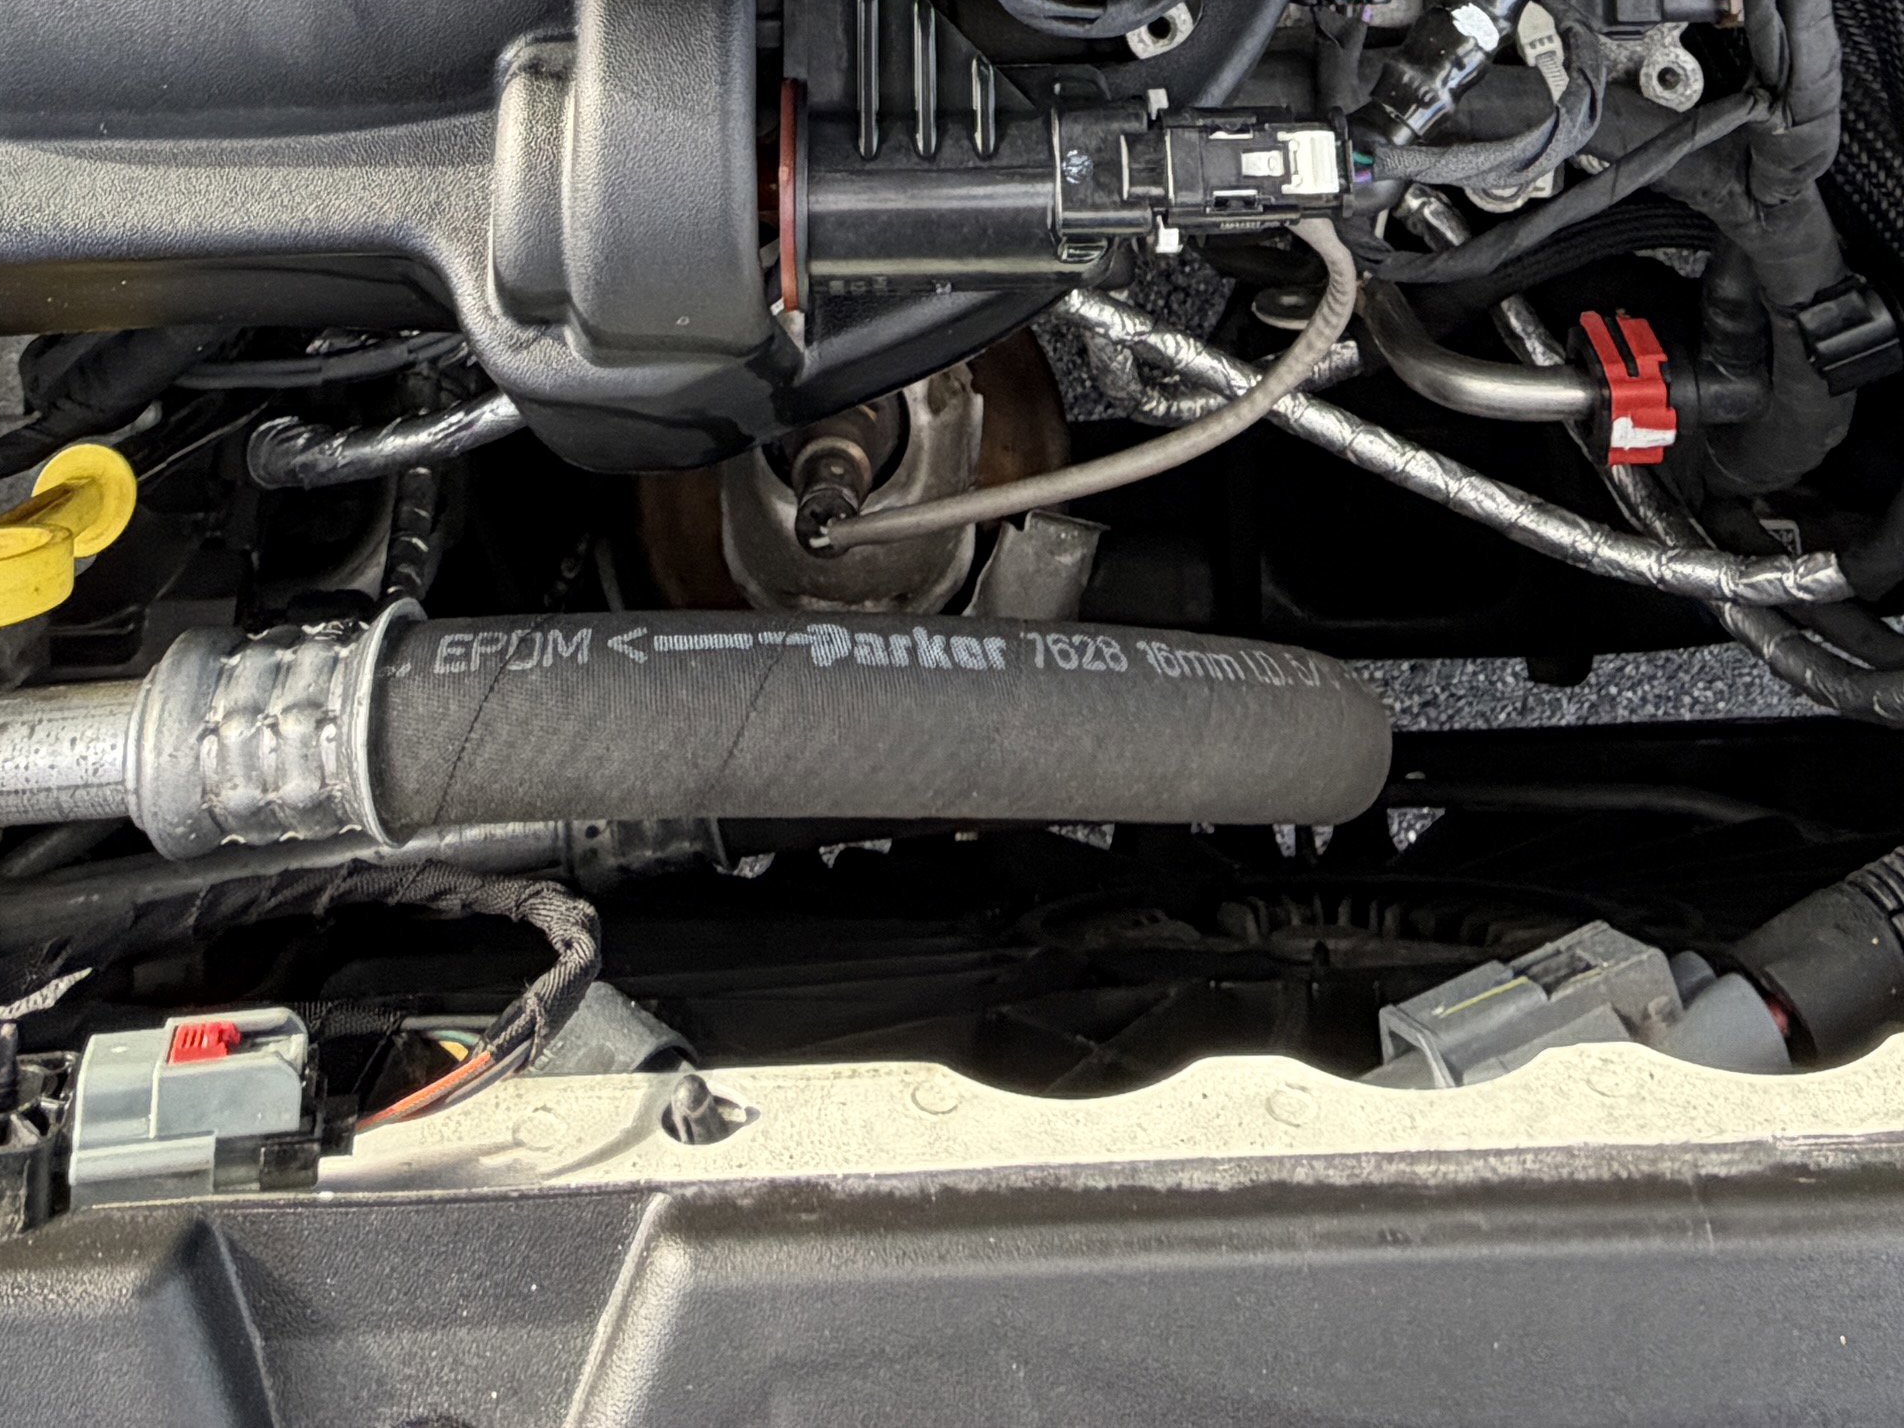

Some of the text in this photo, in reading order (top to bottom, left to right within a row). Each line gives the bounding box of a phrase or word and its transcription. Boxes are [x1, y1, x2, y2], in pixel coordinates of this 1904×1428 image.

[434, 627, 593, 674] EPDM
[807, 622, 1007, 670] Parker
[1020, 631, 1128, 672] 7628
[1137, 639, 1246, 682] 16mm
